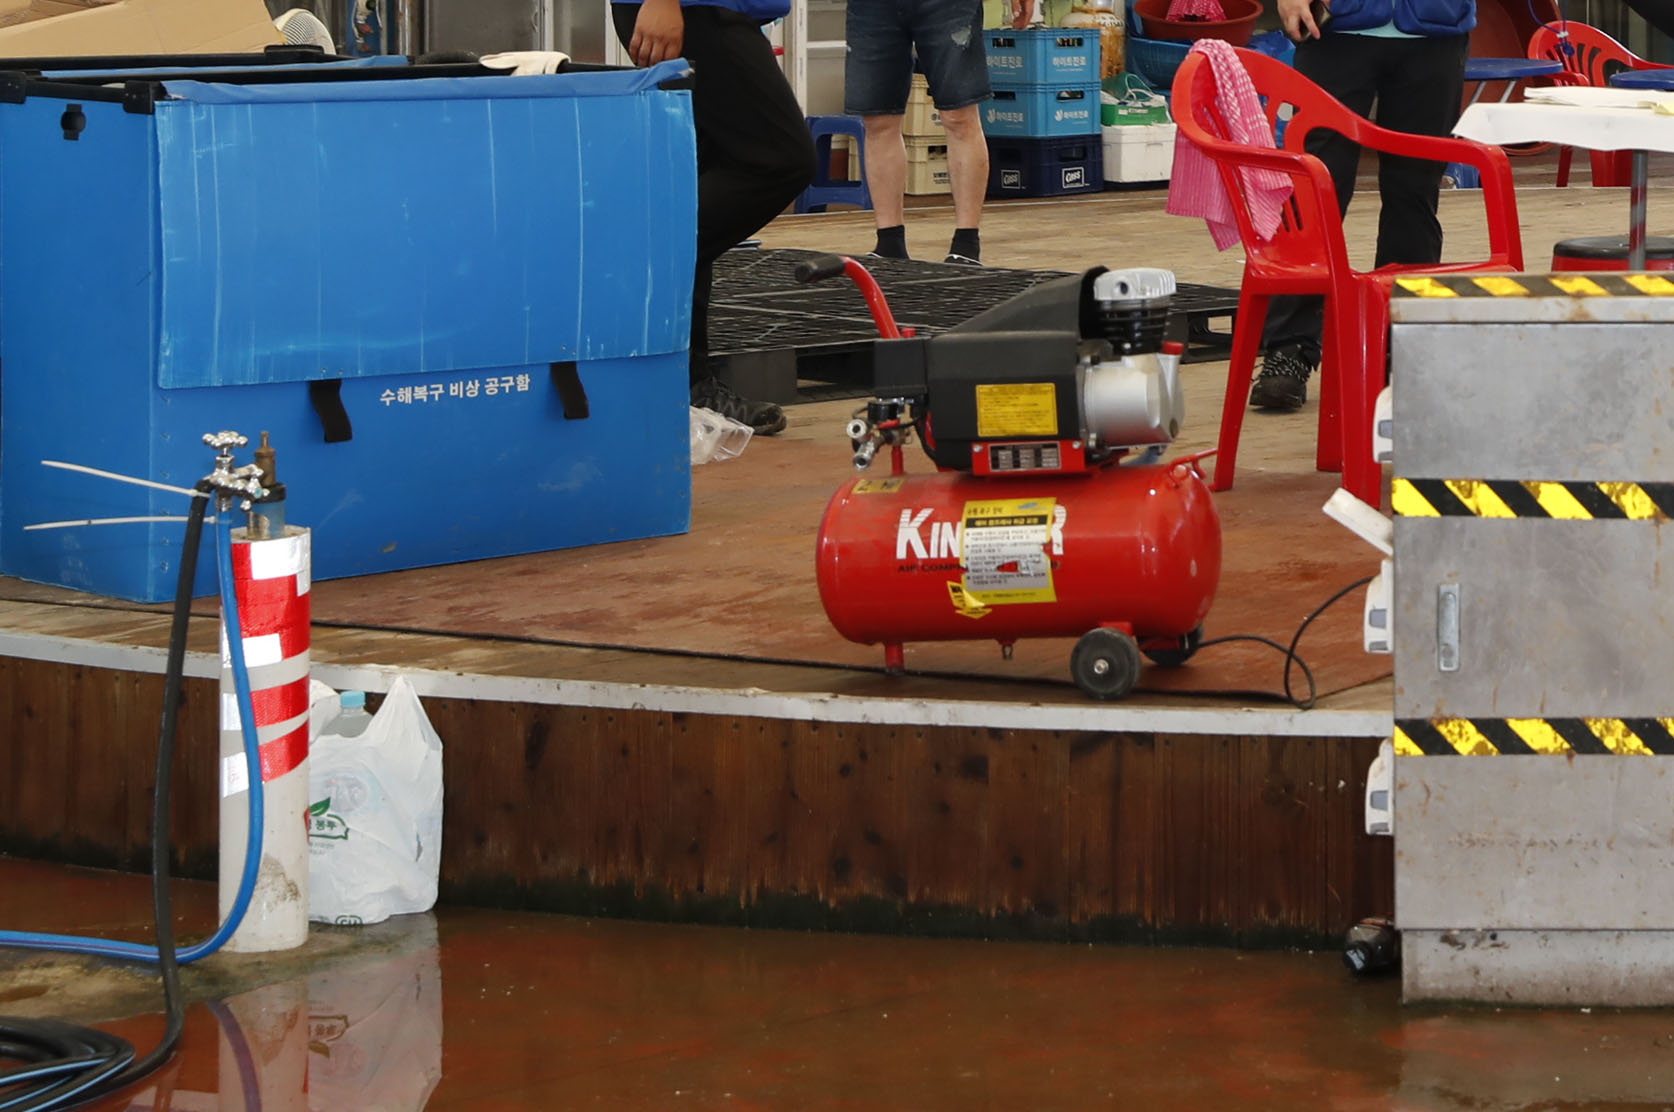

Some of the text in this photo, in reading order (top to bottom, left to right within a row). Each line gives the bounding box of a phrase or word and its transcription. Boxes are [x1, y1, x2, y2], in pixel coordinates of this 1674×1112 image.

[986, 56, 1024, 69] 하이트진로
[1052, 56, 1087, 68] 하이트진로
[996, 112, 1024, 123] 하이트진로
[1063, 110, 1089, 120] 하이트진로
[380, 373, 531, 406] 수해복구 비상 공구함
